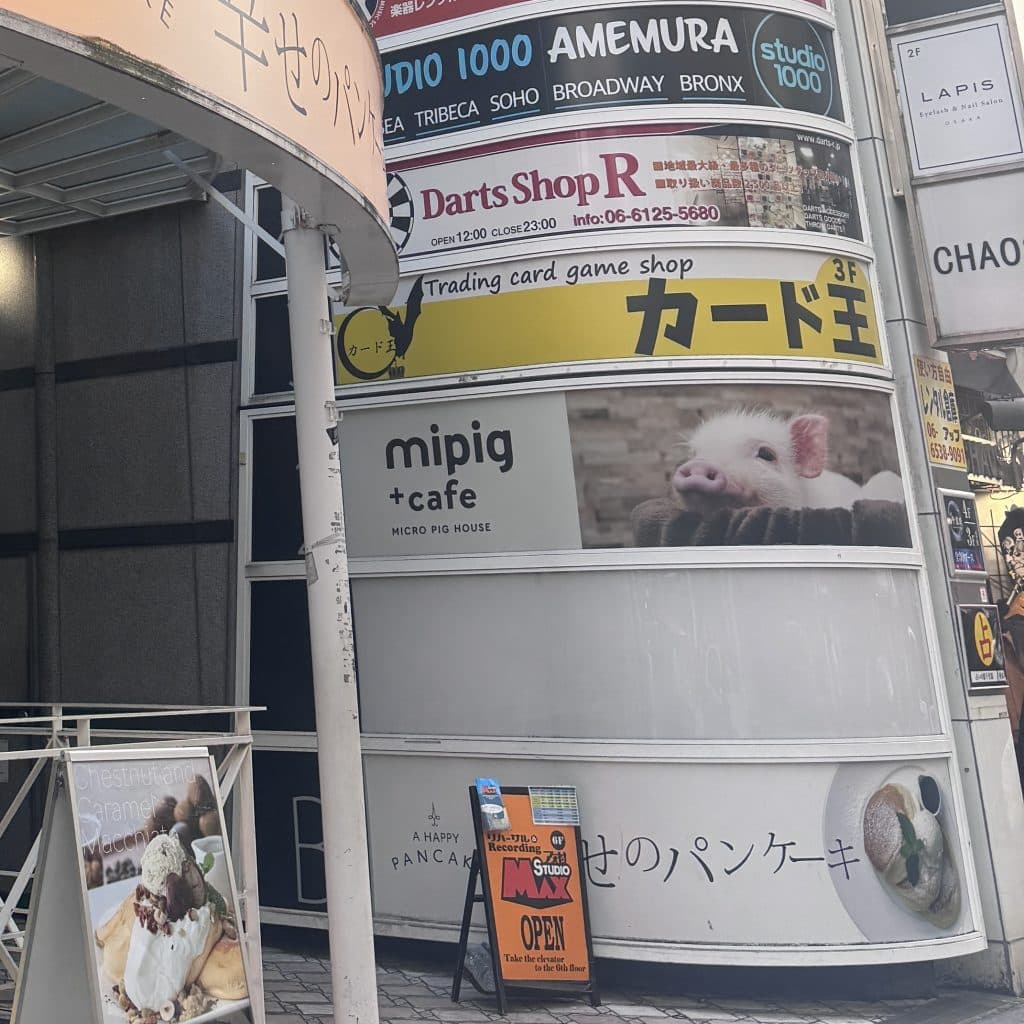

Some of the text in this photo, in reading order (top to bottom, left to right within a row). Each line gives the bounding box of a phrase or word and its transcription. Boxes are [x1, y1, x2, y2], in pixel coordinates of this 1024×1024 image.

[547, 18, 739, 64] AMEMURA
[760, 38, 826, 73] studio
[907, 47, 921, 58] 2F
[775, 64, 822, 94] 1000
[921, 79, 994, 103] LAPIS
[414, 100, 480, 127] TRIBECA
[490, 87, 540, 112] SOHO
[553, 75, 665, 100] BROADWAY
[680, 75, 745, 93] BRONX
[420, 151, 647, 220] Darts Shop R
[431, 216, 557, 247] OPEN 12:00 CLOSE 23:00
[833, 258, 858, 284] 3F
[933, 237, 1024, 275] CHAO
[425, 253, 694, 299] Trading card game shop
[626, 277, 877, 358] カード王
[349, 339, 396, 357] カード王
[385, 420, 512, 475] mipig
[392, 522, 492, 536] MICRO PIG HOUSE
[413, 832, 459, 844] A HAPPY
[488, 843, 542, 855] Recording
[391, 849, 473, 870] PANCAK
[533, 859, 571, 877] STUDIO
[503, 858, 572, 900] MAX
[520, 915, 566, 951] OPEN
[504, 954, 564, 963] Take the elevator
[535, 964, 542, 972] to
[543, 964, 555, 972] the
[570, 964, 586, 972] floor
